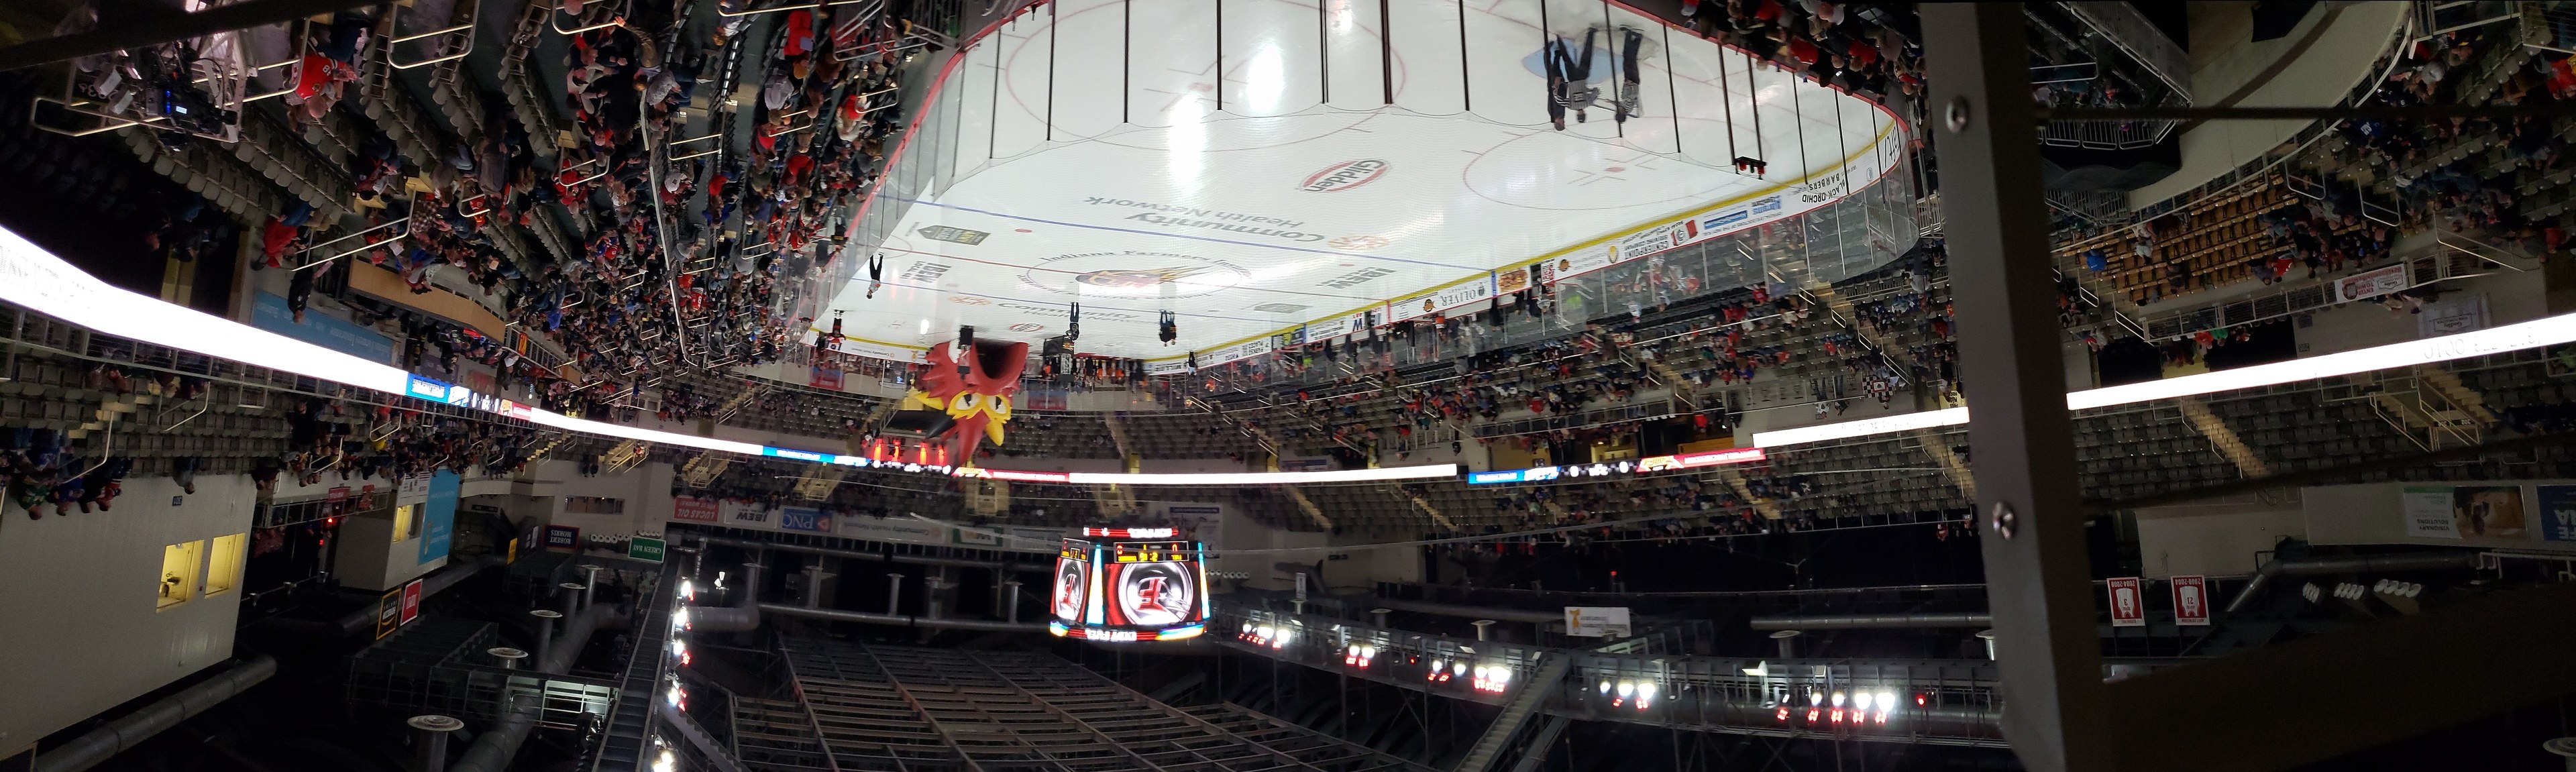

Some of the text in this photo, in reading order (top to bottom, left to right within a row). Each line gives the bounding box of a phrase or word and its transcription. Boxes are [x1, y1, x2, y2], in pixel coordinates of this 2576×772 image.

[1303, 160, 1385, 192] Glidden
[1809, 173, 1840, 191] BARBERS
[1801, 178, 1845, 203] BLACK ORCHID
[1083, 196, 1305, 228] Health Network
[1124, 211, 1326, 243] Community
[2086, 229, 2096, 237] 106
[1038, 252, 1115, 262] Indiana
[1123, 250, 1212, 262] Farmers
[911, 262, 951, 284] IBEW
[1327, 268, 1397, 289] IBEW
[1440, 289, 1477, 307] OLIVER
[677, 508, 716, 520] LUCAS OIL
[736, 512, 767, 522] IBEW
[782, 513, 814, 530] PNC
[550, 529, 572, 538] MORRIS
[892, 525, 929, 536] Community
[549, 537, 572, 545] ROBERT
[633, 544, 661, 554] GREEN BAY
[2174, 577, 2201, 586] 2000-2004
[2187, 597, 2194, 605] 21
[1085, 629, 1137, 641] INDY FUEL
